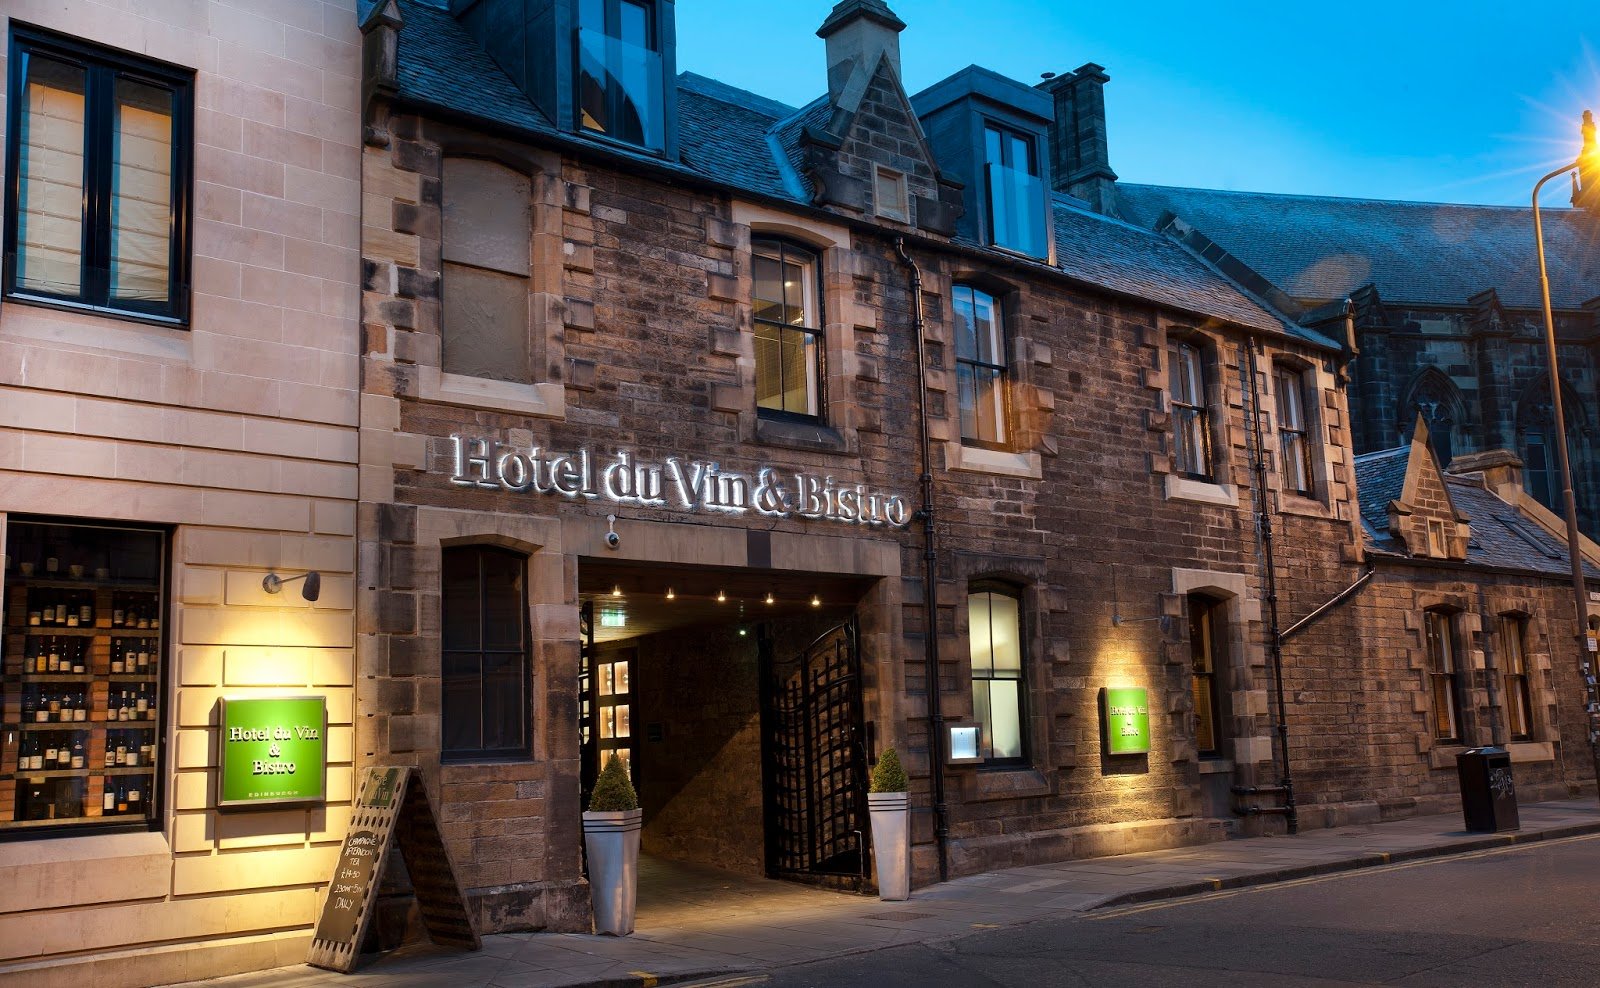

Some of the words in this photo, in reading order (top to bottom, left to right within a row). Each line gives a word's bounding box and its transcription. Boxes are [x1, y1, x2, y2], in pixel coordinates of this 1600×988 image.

[450, 433, 600, 500] Hotel
[605, 449, 665, 503] du
[666, 457, 750, 514] Vin
[754, 467, 792, 516] &
[796, 472, 912, 527] Bistro
[229, 727, 269, 742] Hotel
[274, 726, 291, 741] du
[294, 725, 319, 740] Vin
[269, 742, 280, 758] &
[252, 760, 296, 775] Bistro
[350, 858, 360, 866] TEA
[335, 897, 354, 911] DAILY
